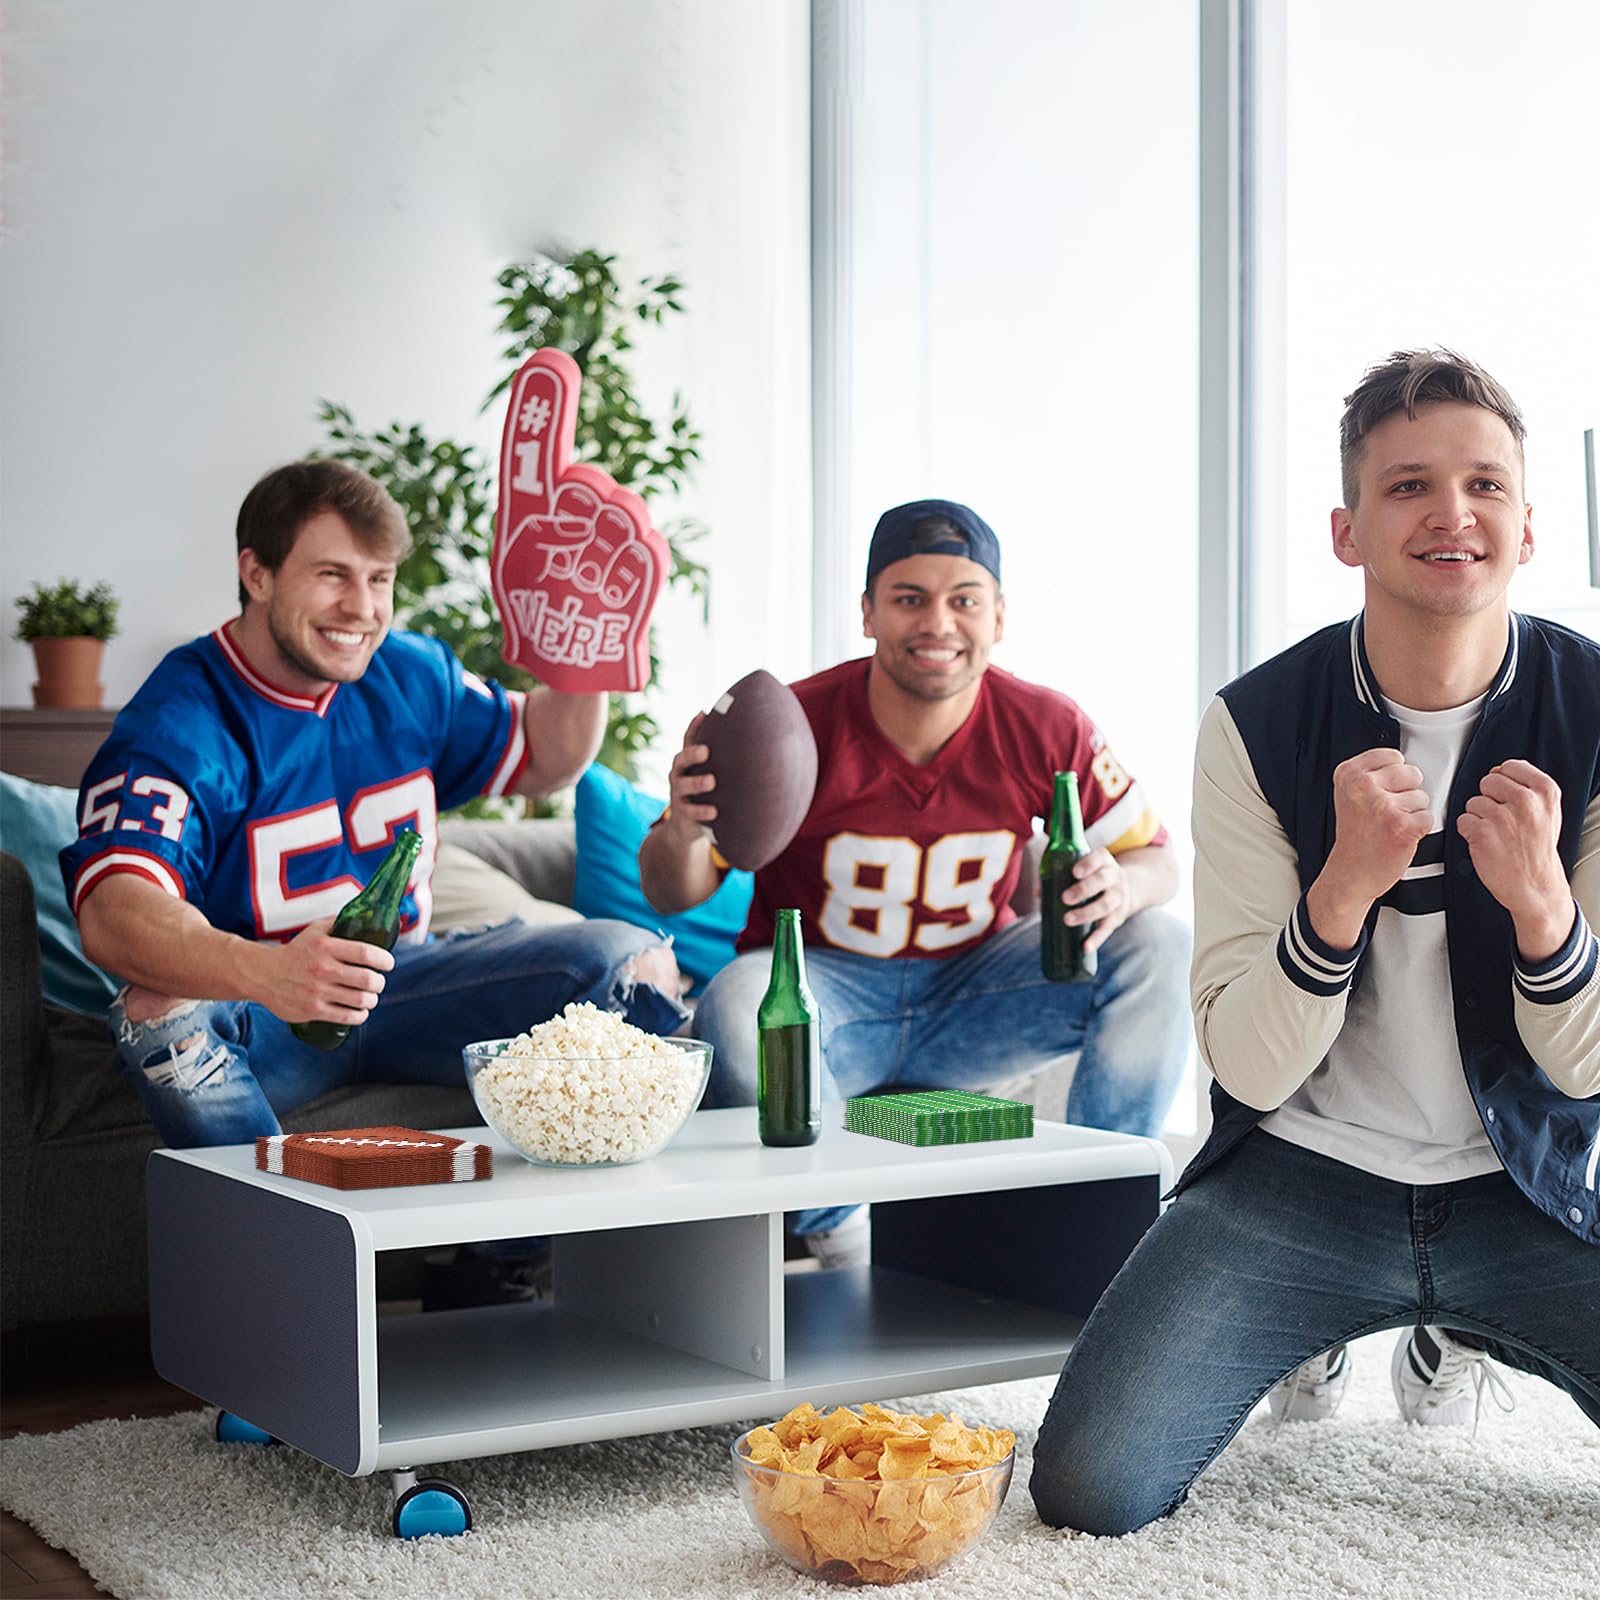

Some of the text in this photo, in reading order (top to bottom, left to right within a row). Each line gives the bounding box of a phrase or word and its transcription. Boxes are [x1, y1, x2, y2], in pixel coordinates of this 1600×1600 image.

[511, 440, 544, 497] 1
[79, 772, 190, 842] 53
[819, 829, 1016, 959] 89
